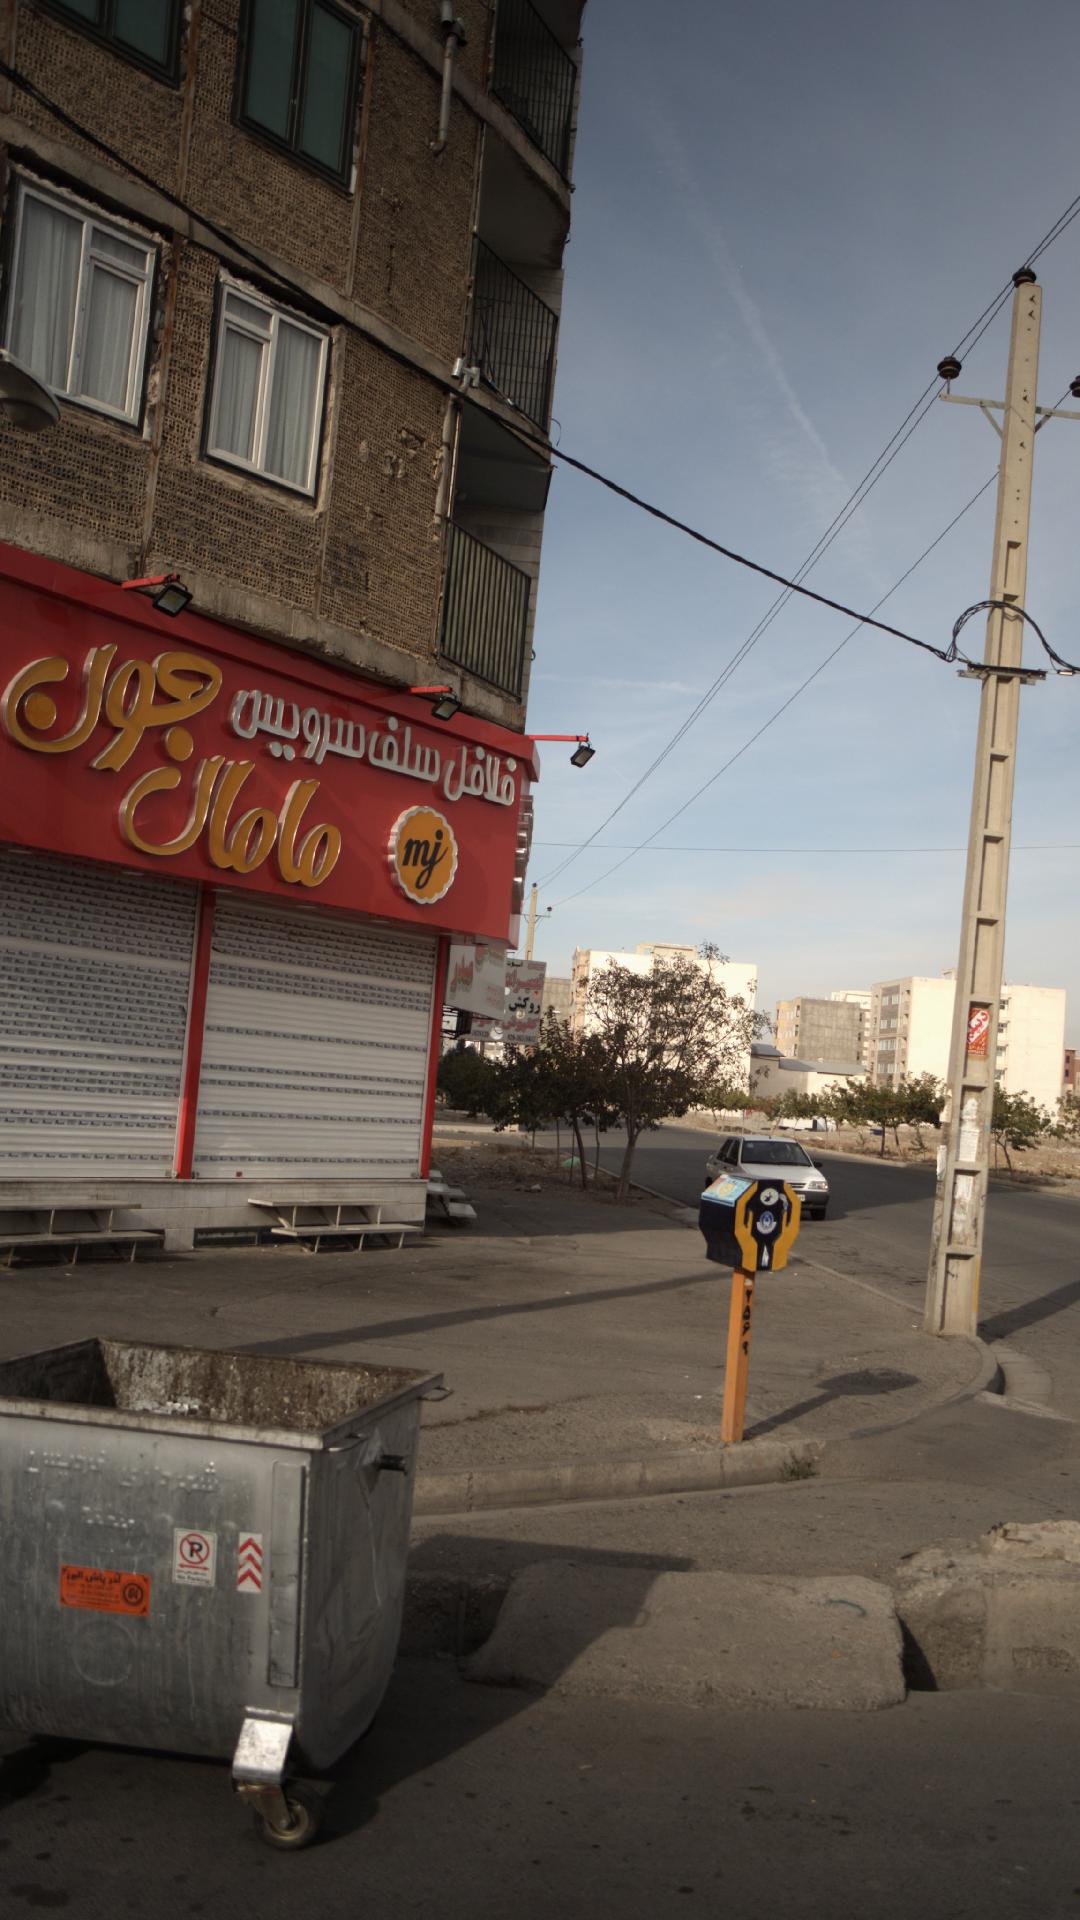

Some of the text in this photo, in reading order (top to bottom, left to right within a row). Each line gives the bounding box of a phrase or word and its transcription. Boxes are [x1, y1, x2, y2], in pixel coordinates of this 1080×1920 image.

[2, 643, 222, 772] جون
[231, 689, 517, 806] فلافل سلف سرویس
[119, 755, 341, 888] مامان
[508, 997, 541, 1014] روکش
